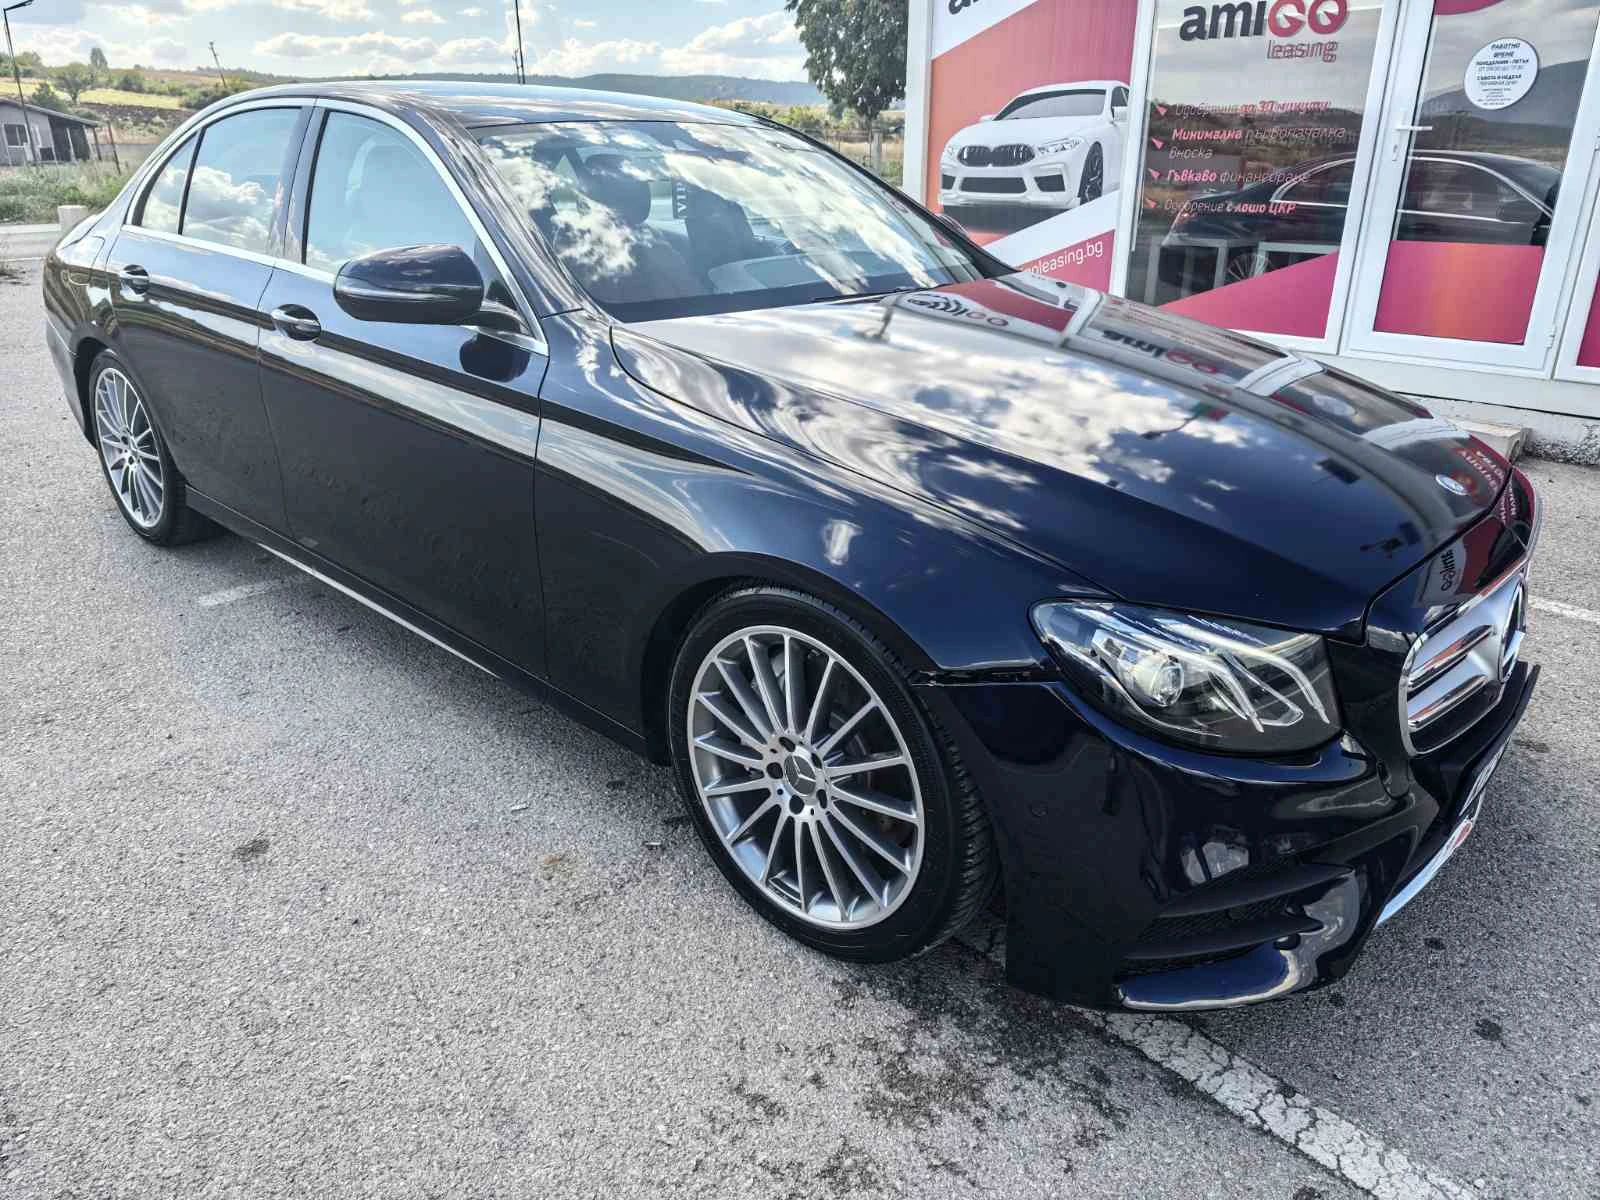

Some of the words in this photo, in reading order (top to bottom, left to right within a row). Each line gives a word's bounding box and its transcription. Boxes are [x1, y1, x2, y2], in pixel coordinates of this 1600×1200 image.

[1267, 40, 1338, 63] leasing
[1171, 127, 1242, 141] Минимална
[1166, 168, 1217, 183] Гъвкаво
[1267, 201, 1297, 216] ЦКР
